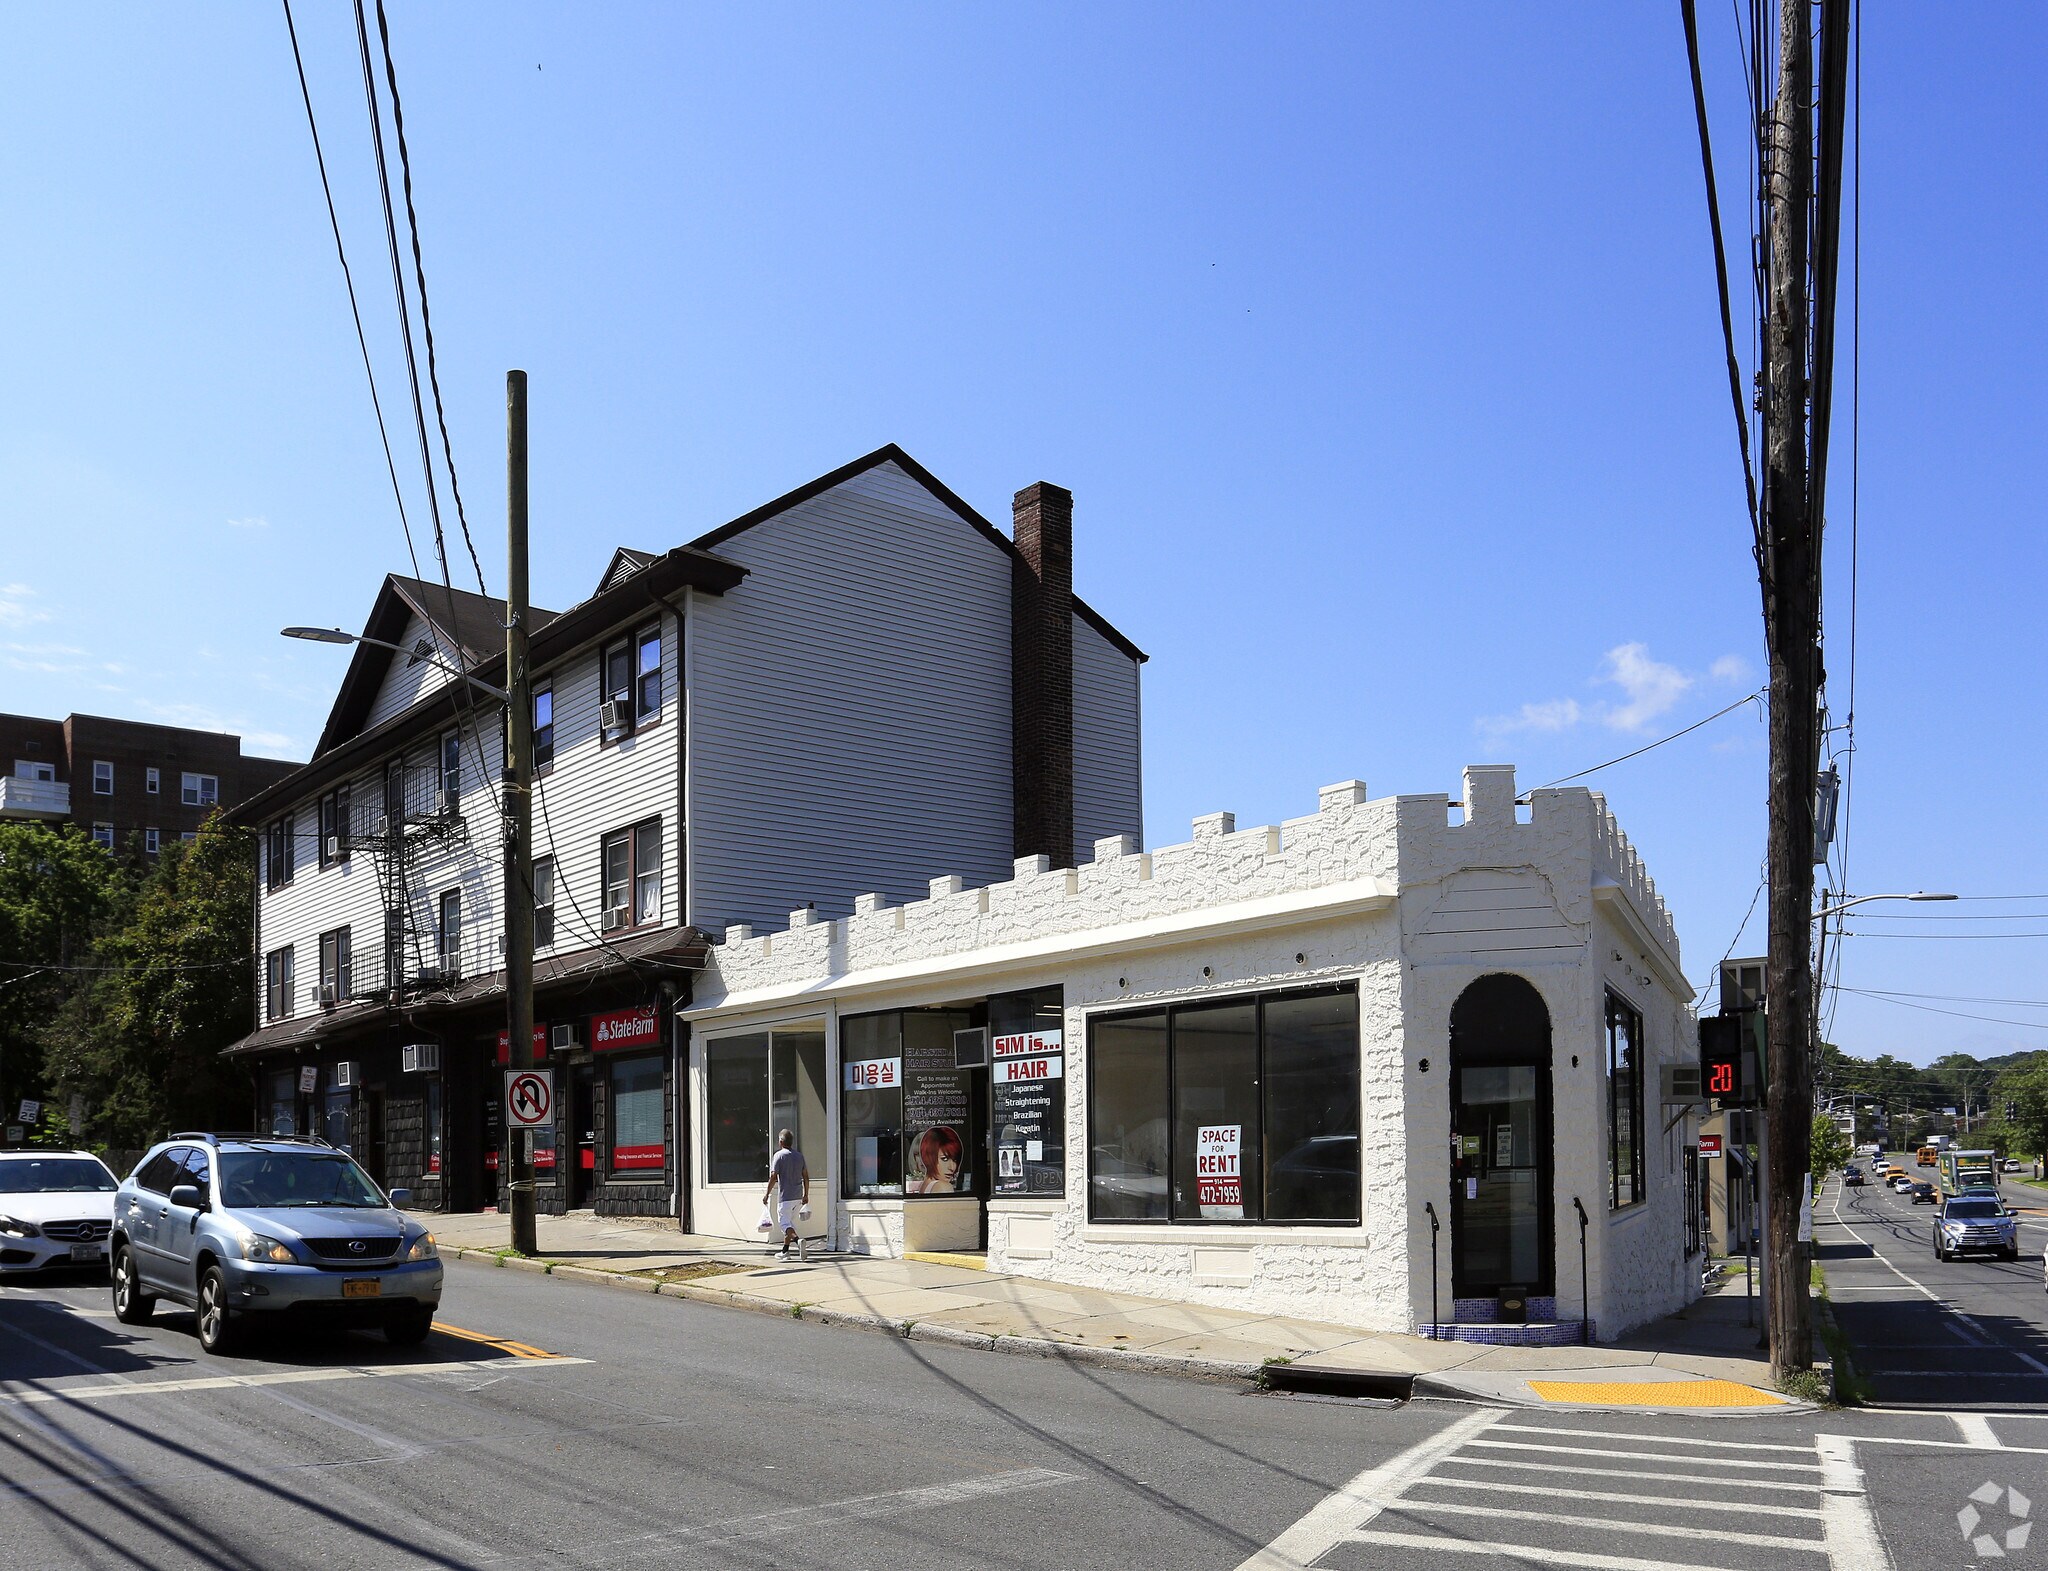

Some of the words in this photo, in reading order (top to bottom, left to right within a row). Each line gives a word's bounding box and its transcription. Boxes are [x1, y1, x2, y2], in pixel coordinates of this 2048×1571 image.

[995, 1036, 1024, 1055] SIM
[1028, 1035, 1060, 1051] is...
[905, 1059, 931, 1068] HAIR
[1007, 1060, 1048, 1080] HAIR
[852, 1062, 894, 1085] 미용실
[1710, 1063, 1732, 1092] 20
[1011, 1084, 1044, 1094] Japanese
[1005, 1097, 1051, 1107] Straightening
[20, 1111, 36, 1121] 25
[1013, 1110, 1042, 1120] Brazilian
[1015, 1123, 1041, 1133] Keratin
[1202, 1130, 1236, 1143] SPACE
[1211, 1145, 1225, 1153] FOR
[1199, 1155, 1237, 1173] RENT
[1035, 1172, 1063, 1185] OPEN
[1200, 1186, 1240, 1203] 472-7959
